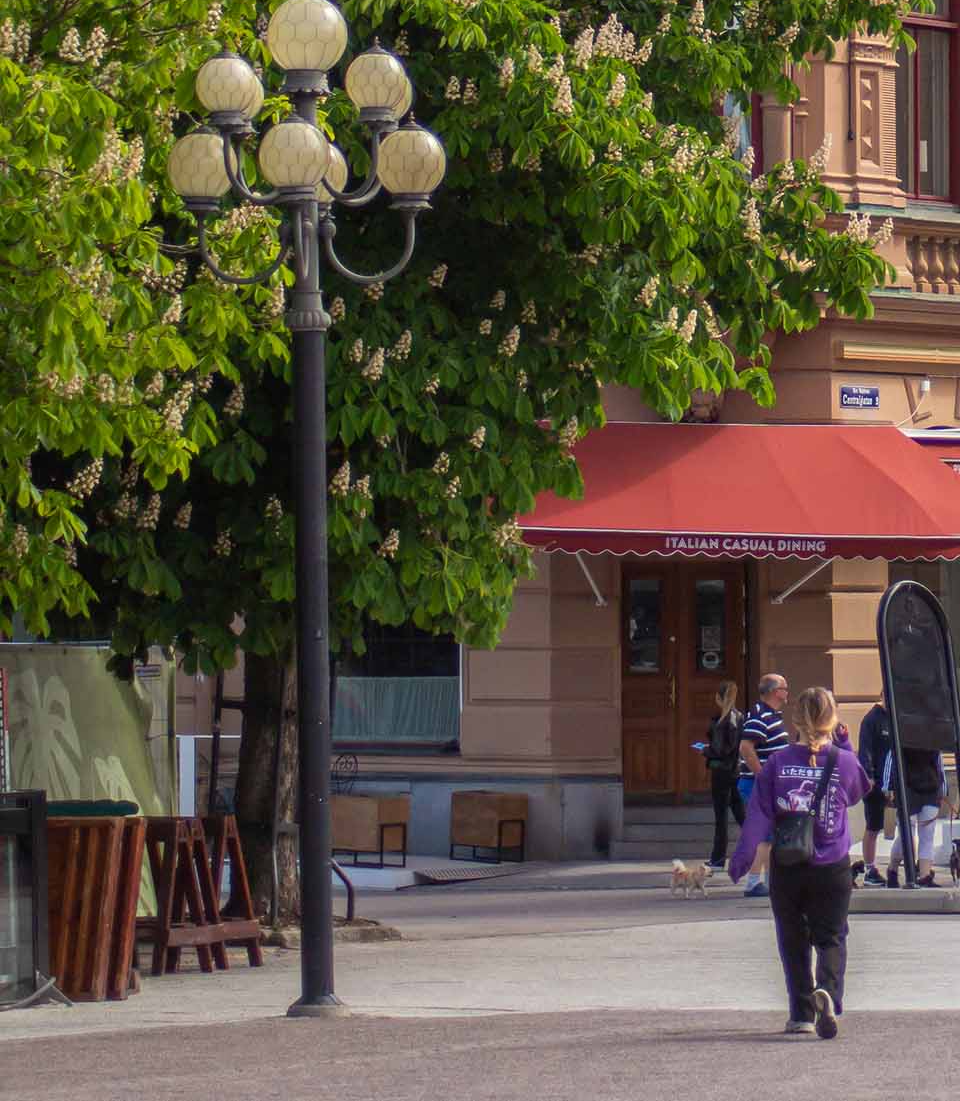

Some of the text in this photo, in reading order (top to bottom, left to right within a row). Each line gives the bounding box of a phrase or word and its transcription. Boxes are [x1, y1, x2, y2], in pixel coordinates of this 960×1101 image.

[665, 536, 827, 553] ITALIAN CASUAL DINING
